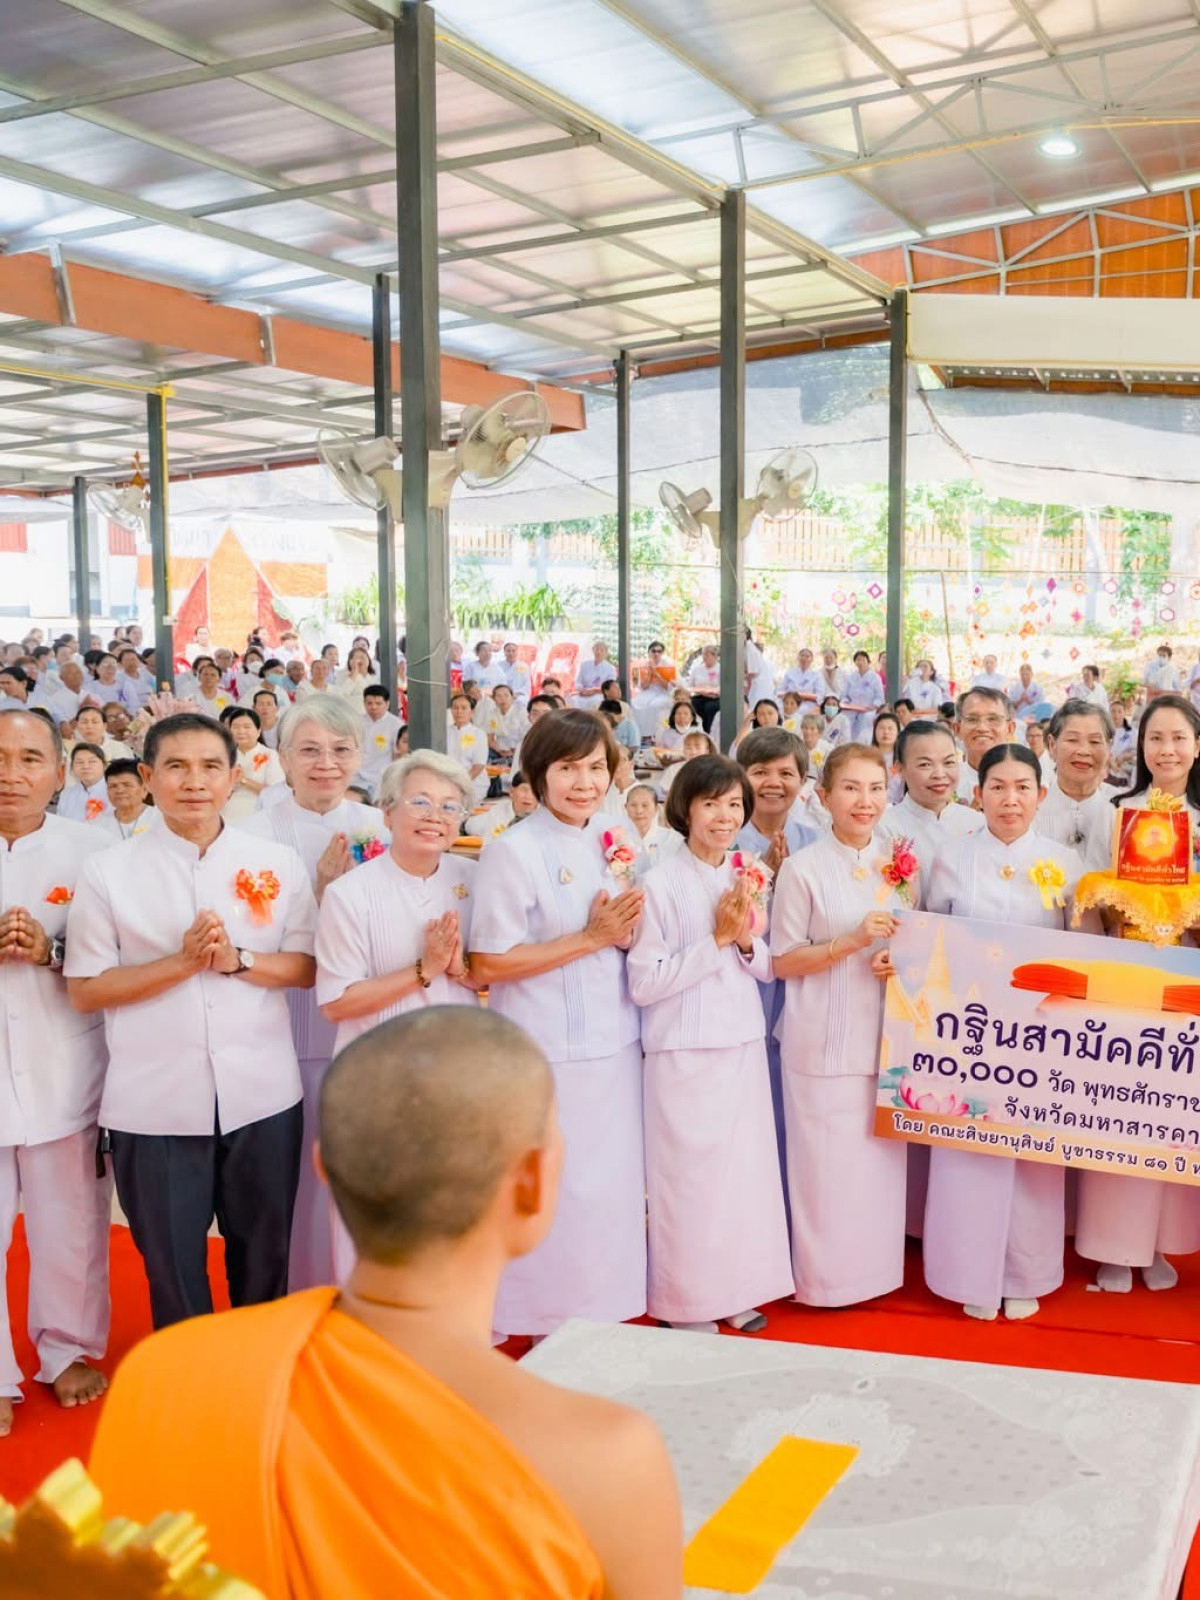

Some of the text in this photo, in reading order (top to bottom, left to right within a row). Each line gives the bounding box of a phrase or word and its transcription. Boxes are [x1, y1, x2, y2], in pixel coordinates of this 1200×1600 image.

[912, 1051, 1038, 1089] ๓๐,๐๐๐
[1048, 1069, 1075, 1095] วัด
[893, 1113, 923, 1133] โดย
[929, 1123, 1056, 1153] คณะศิษยานุศิษย์
[1062, 1143, 1138, 1166] บูชาธรรม
[1144, 1156, 1168, 1171] ๘๑
[1175, 1156, 1187, 1173] ปี
